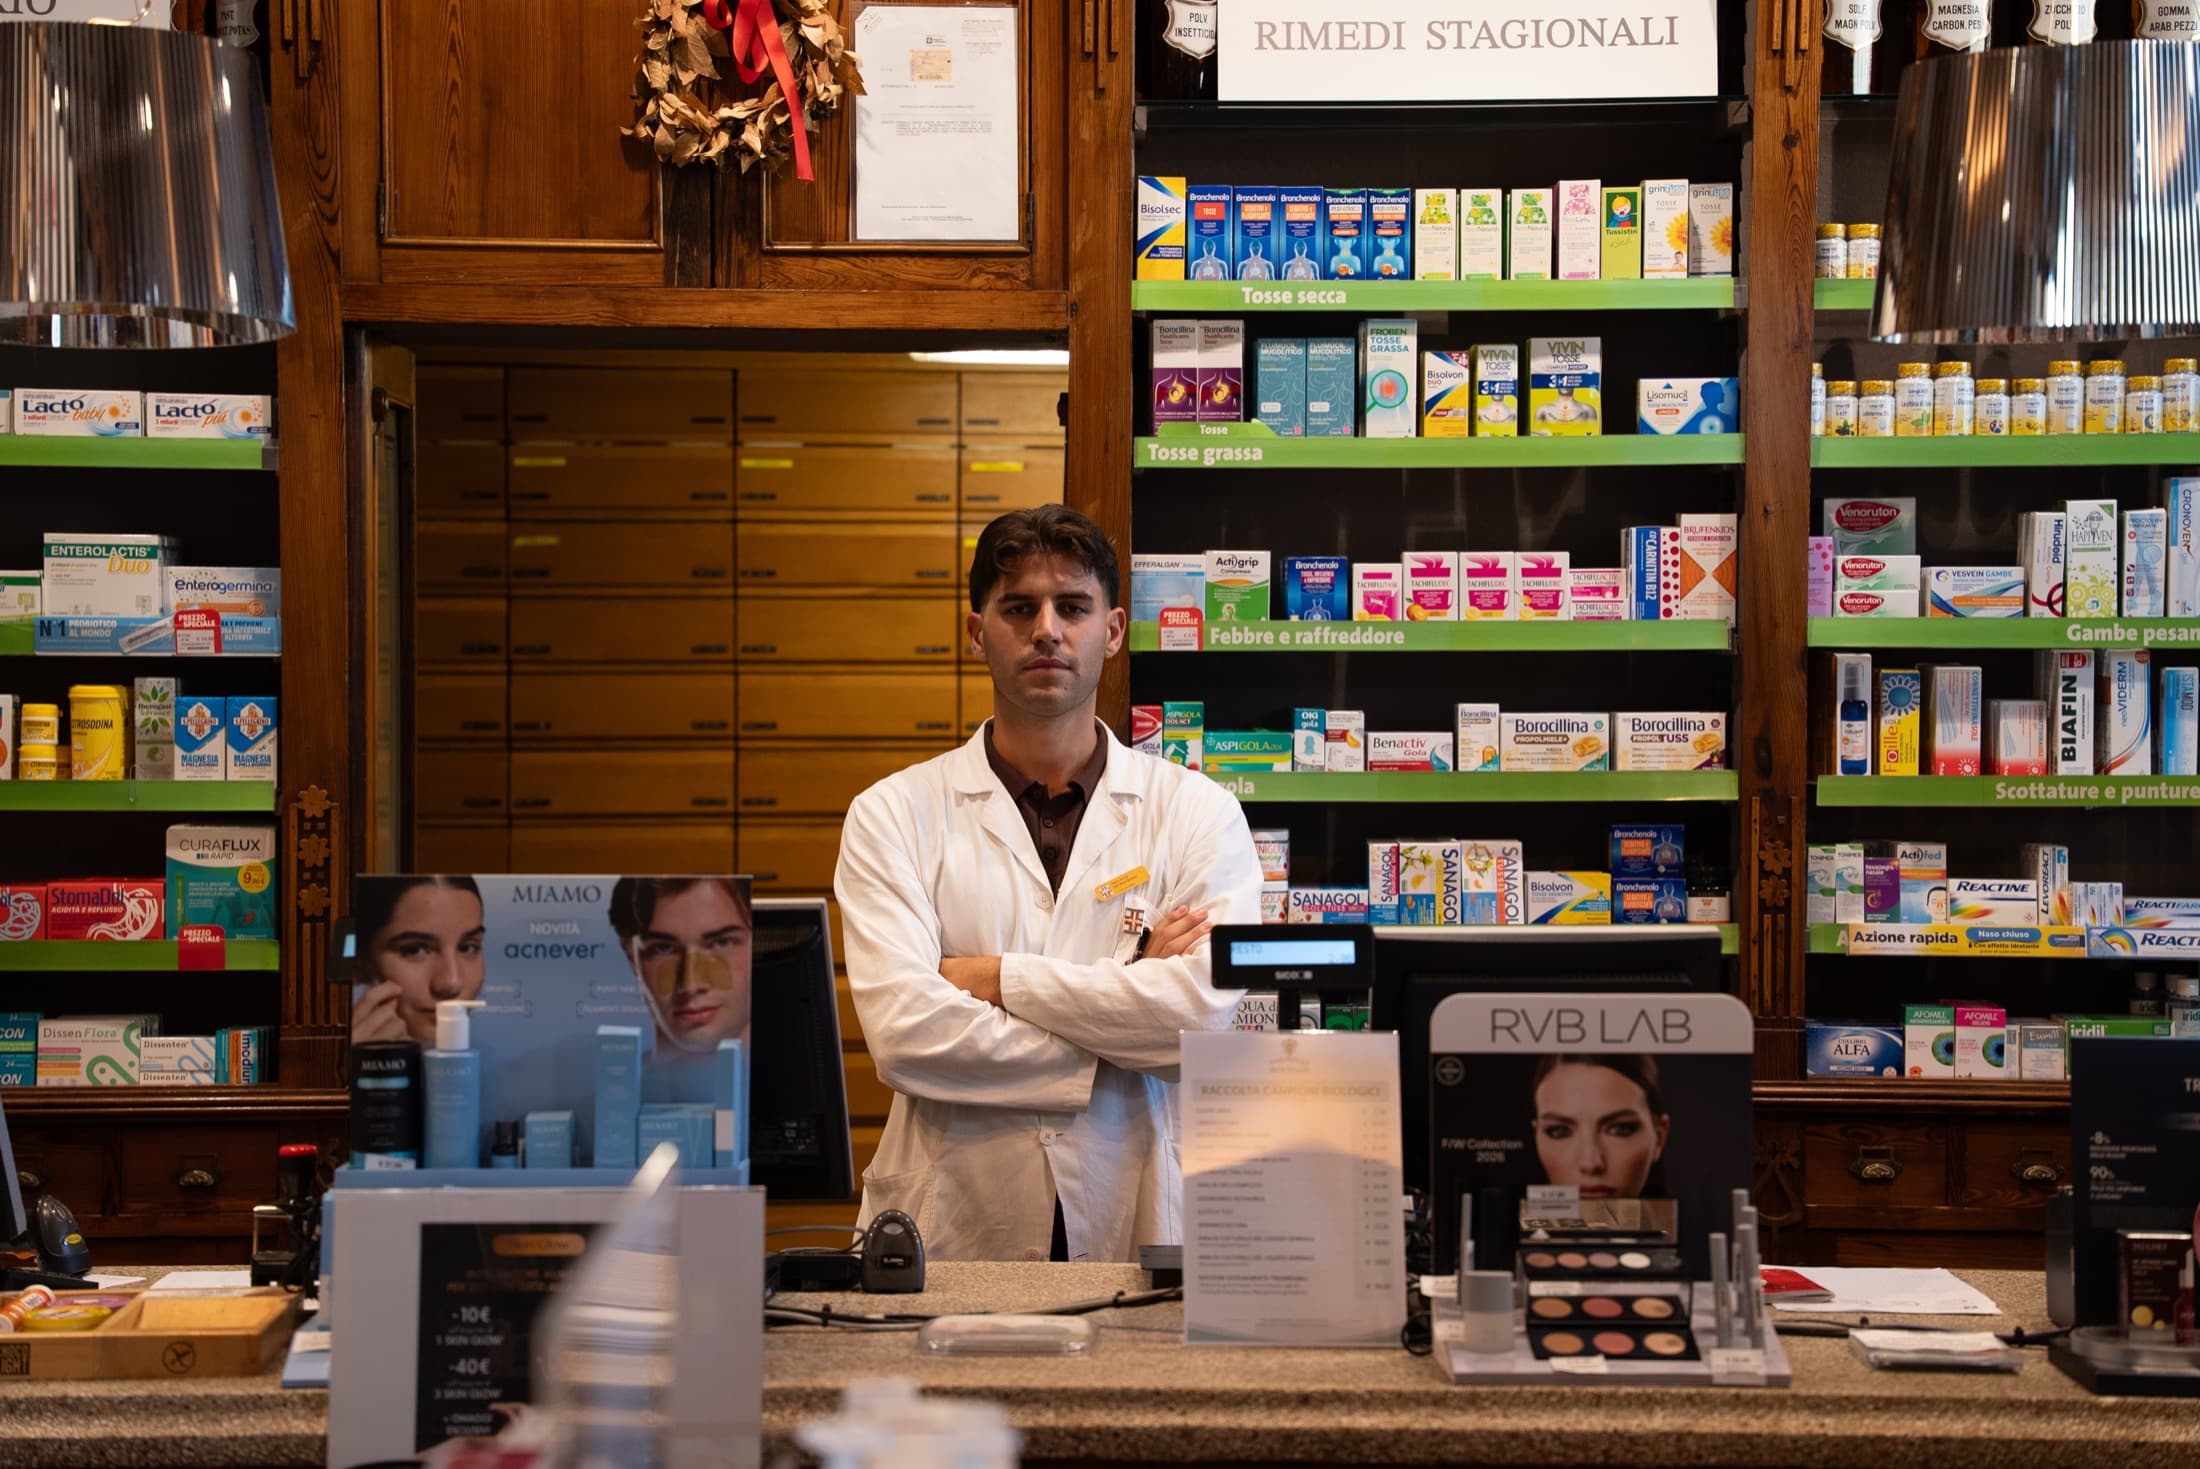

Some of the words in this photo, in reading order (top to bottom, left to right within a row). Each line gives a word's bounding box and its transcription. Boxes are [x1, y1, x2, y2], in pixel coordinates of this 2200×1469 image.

[1938, 5, 1980, 15] MAGNESIA
[2158, 6, 2190, 16] GOMMA
[1254, 21, 1407, 50] RIMEDI
[1426, 16, 1680, 50] STAGIONALI
[1140, 204, 1181, 214] Bisolsec
[1241, 287, 1292, 305] Tosse
[1297, 289, 1347, 305] secca
[1370, 328, 1408, 337] FROBEN
[1370, 336, 1401, 345] TOSSE
[1370, 345, 1410, 353] GRASSA
[1547, 341, 1586, 353] VIVIN
[1480, 350, 1515, 361] VIVIN
[1552, 354, 1581, 364] TOSSE
[1485, 362, 1511, 371] TOSSE
[1427, 370, 1464, 379] Bisolvon
[1646, 390, 1689, 401] Lisomucil
[72, 406, 107, 422] baby
[1199, 425, 1228, 436] Tosse
[1147, 443, 1199, 461] Tosse
[1203, 446, 1263, 466] grassa
[1839, 506, 1897, 517] Venoruton
[51, 546, 148, 557] ENTEROLACTIS
[107, 557, 151, 574] Duo
[1295, 560, 1339, 570] Bronchenolo
[1844, 561, 1884, 570] Venoruton
[174, 579, 272, 594] enterogermina
[1842, 596, 1882, 604] Venoruton
[69, 620, 117, 628] PROBIOTICO
[80, 629, 111, 638] MONDO
[1209, 626, 1274, 644] Febbre
[1279, 630, 1290, 644] e
[1296, 625, 1405, 644] raffreddore
[2066, 623, 2138, 641] Gambe
[2061, 674, 2077, 762] BIAFIN
[1301, 721, 1319, 729] gola
[1515, 718, 1589, 733] Borocillina
[1631, 717, 1705, 732] Borocillina
[1373, 737, 1426, 749] Benactiv
[181, 754, 218, 763] MAGNESIA
[234, 754, 271, 763] MAGNESIA
[1995, 782, 2099, 799] Scottature
[2104, 785, 2116, 799] e
[2121, 782, 2200, 805] punture
[1614, 828, 1658, 838] Bronchenolo
[179, 839, 260, 852] CURAFLUX
[1381, 850, 1393, 903] SANAGOL
[1531, 881, 1574, 893] Bisolvon
[1616, 882, 1660, 892] Bronchenolo
[1956, 881, 2029, 893] REACTINE
[2041, 850, 2049, 915] LEVOREACT
[511, 884, 602, 904] MIAMO
[1293, 892, 1365, 907] SANAGOL
[529, 921, 581, 935] NOVITÀ
[1978, 930, 1999, 938] Naso
[2001, 929, 2030, 938] chiuso
[188, 935, 221, 943] SPECIALE
[1853, 930, 1905, 943] Azione
[1909, 932, 1958, 946] rapida
[504, 942, 599, 960] acnever
[1490, 1008, 1587, 1044] RVB
[1600, 1008, 1693, 1044] LAB
[1833, 1044, 1871, 1056] ALFA
[1201, 1086, 1260, 1096] RACCOLTA
